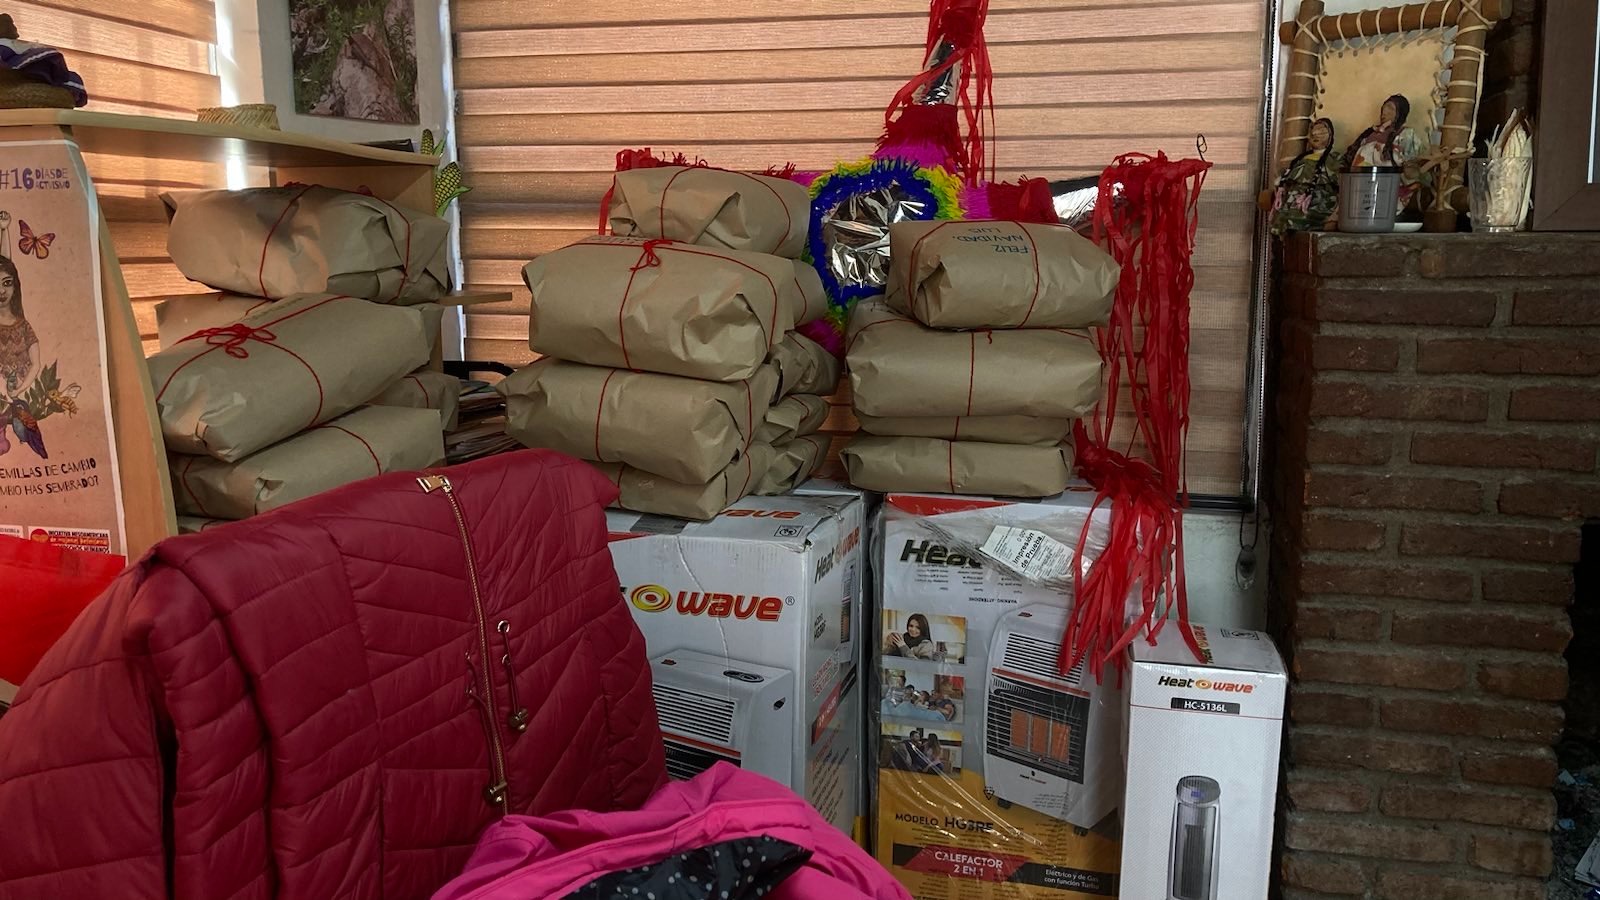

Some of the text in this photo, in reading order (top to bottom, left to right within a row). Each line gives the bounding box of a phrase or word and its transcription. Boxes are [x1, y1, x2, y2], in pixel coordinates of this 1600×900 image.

[0, 168, 34, 190] #16
[992, 244, 1028, 254] FELIZ
[45, 465, 59, 476] DE
[61, 458, 96, 474] CAMBIO
[25, 485, 43, 495] HAS
[46, 475, 99, 493] SEMBRADO?
[1012, 532, 1035, 564] Impresión
[1021, 560, 1029, 568] de
[676, 590, 783, 622] wave
[1158, 675, 1253, 693] Heat wave
[1184, 701, 1227, 712] HC-5136L
[895, 813, 939, 826] MODELO
[934, 851, 1004, 869] CALEFACTOR
[954, 864, 960, 873] 2
[962, 866, 977, 875] EN
[1045, 868, 1072, 878] Eléctrico
[1056, 878, 1080, 887] función
